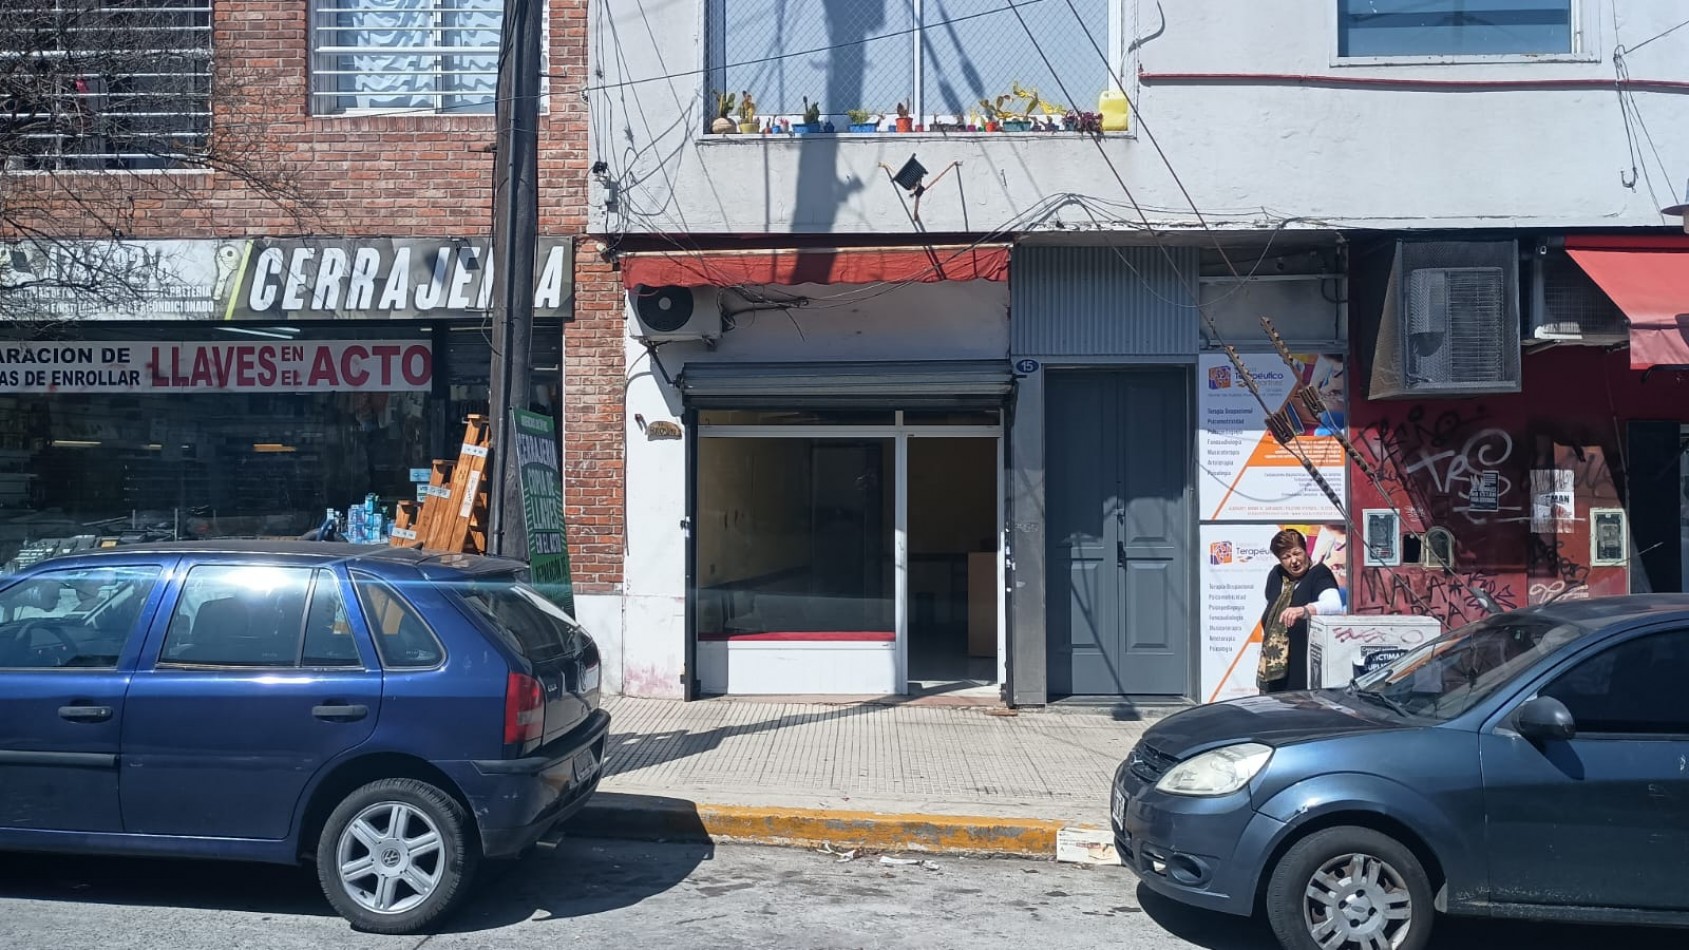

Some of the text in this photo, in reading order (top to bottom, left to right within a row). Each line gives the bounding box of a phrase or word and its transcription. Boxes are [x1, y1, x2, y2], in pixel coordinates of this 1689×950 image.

[249, 246, 565, 311] CERRAJEA
[143, 300, 214, 312] CONDICIONADO
[102, 348, 131, 364] DE
[151, 344, 433, 387] LLAVES EN EL ACTO
[1021, 360, 1034, 372] 15
[25, 371, 46, 386] DE
[52, 370, 140, 387] ENROLLAR
[1235, 371, 1284, 381] Tepéutico
[1236, 547, 1271, 556] Terapéu
